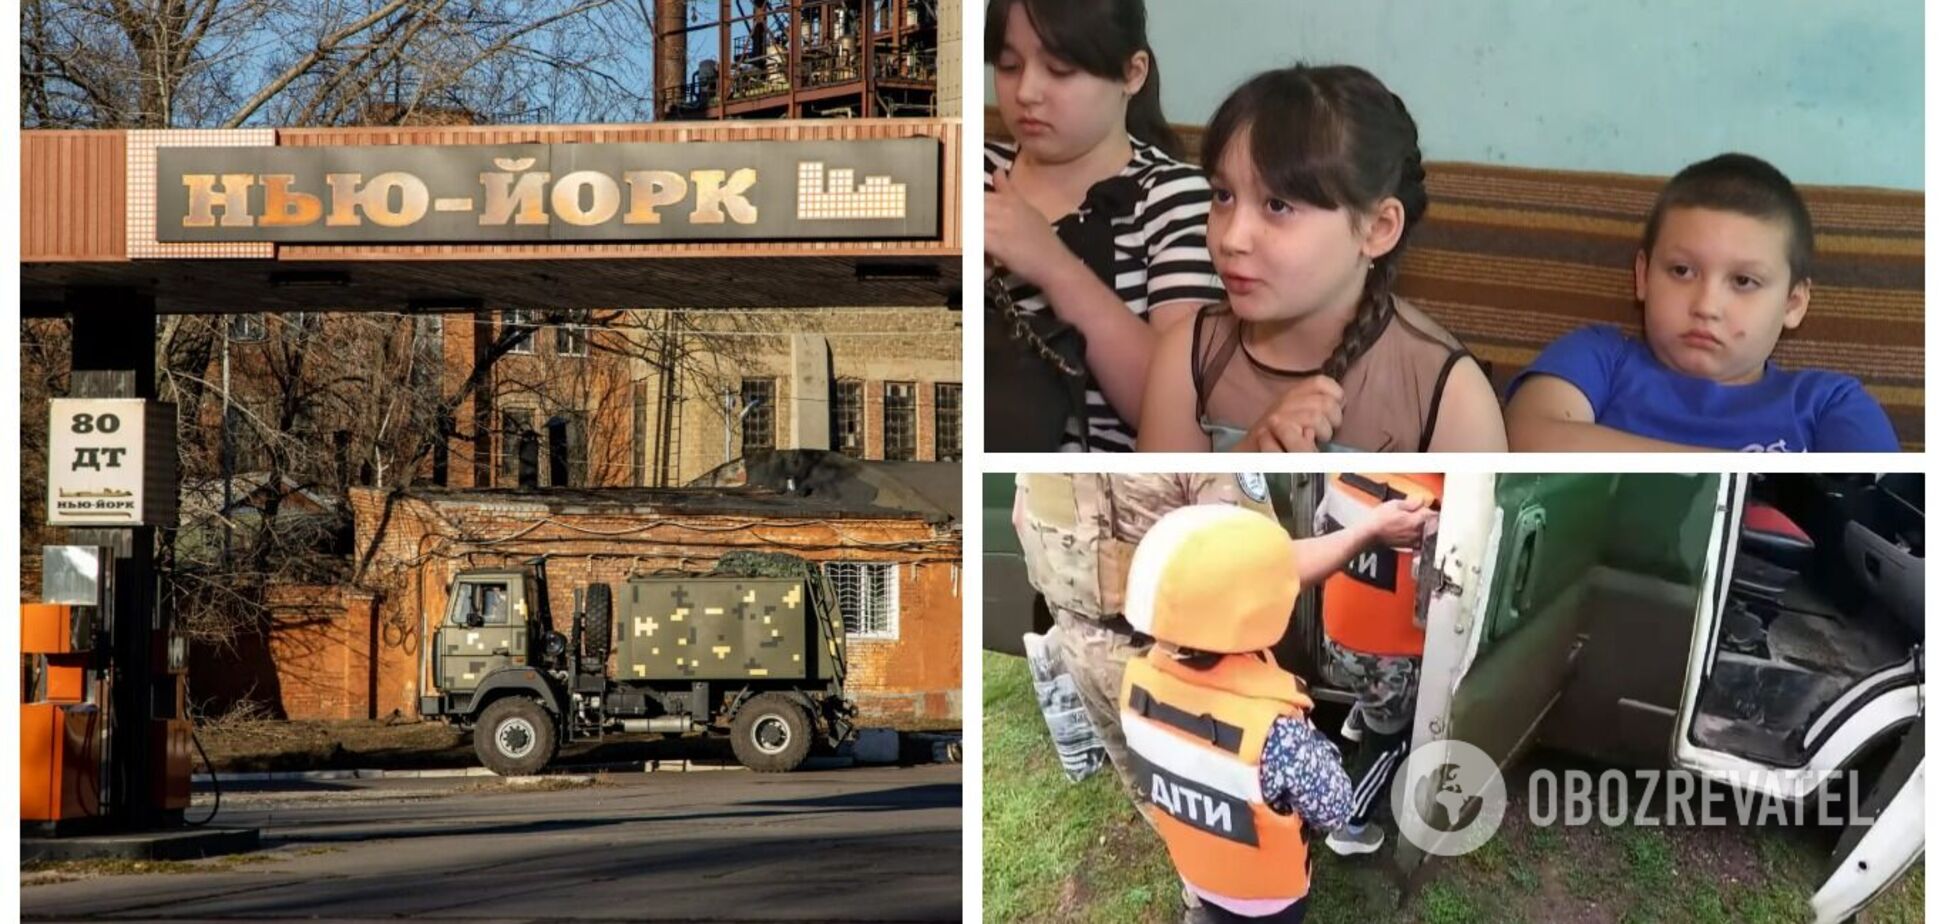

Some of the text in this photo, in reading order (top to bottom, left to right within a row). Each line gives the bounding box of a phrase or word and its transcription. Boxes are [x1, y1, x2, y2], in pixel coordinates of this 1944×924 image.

[182, 157, 758, 228] НЬЮ-ЙОРК
[71, 413, 120, 434] 80
[72, 447, 126, 472] ДТ
[57, 499, 134, 509] НЬЮ-ЙОРК
[1151, 773, 1232, 832] ДІТИ
